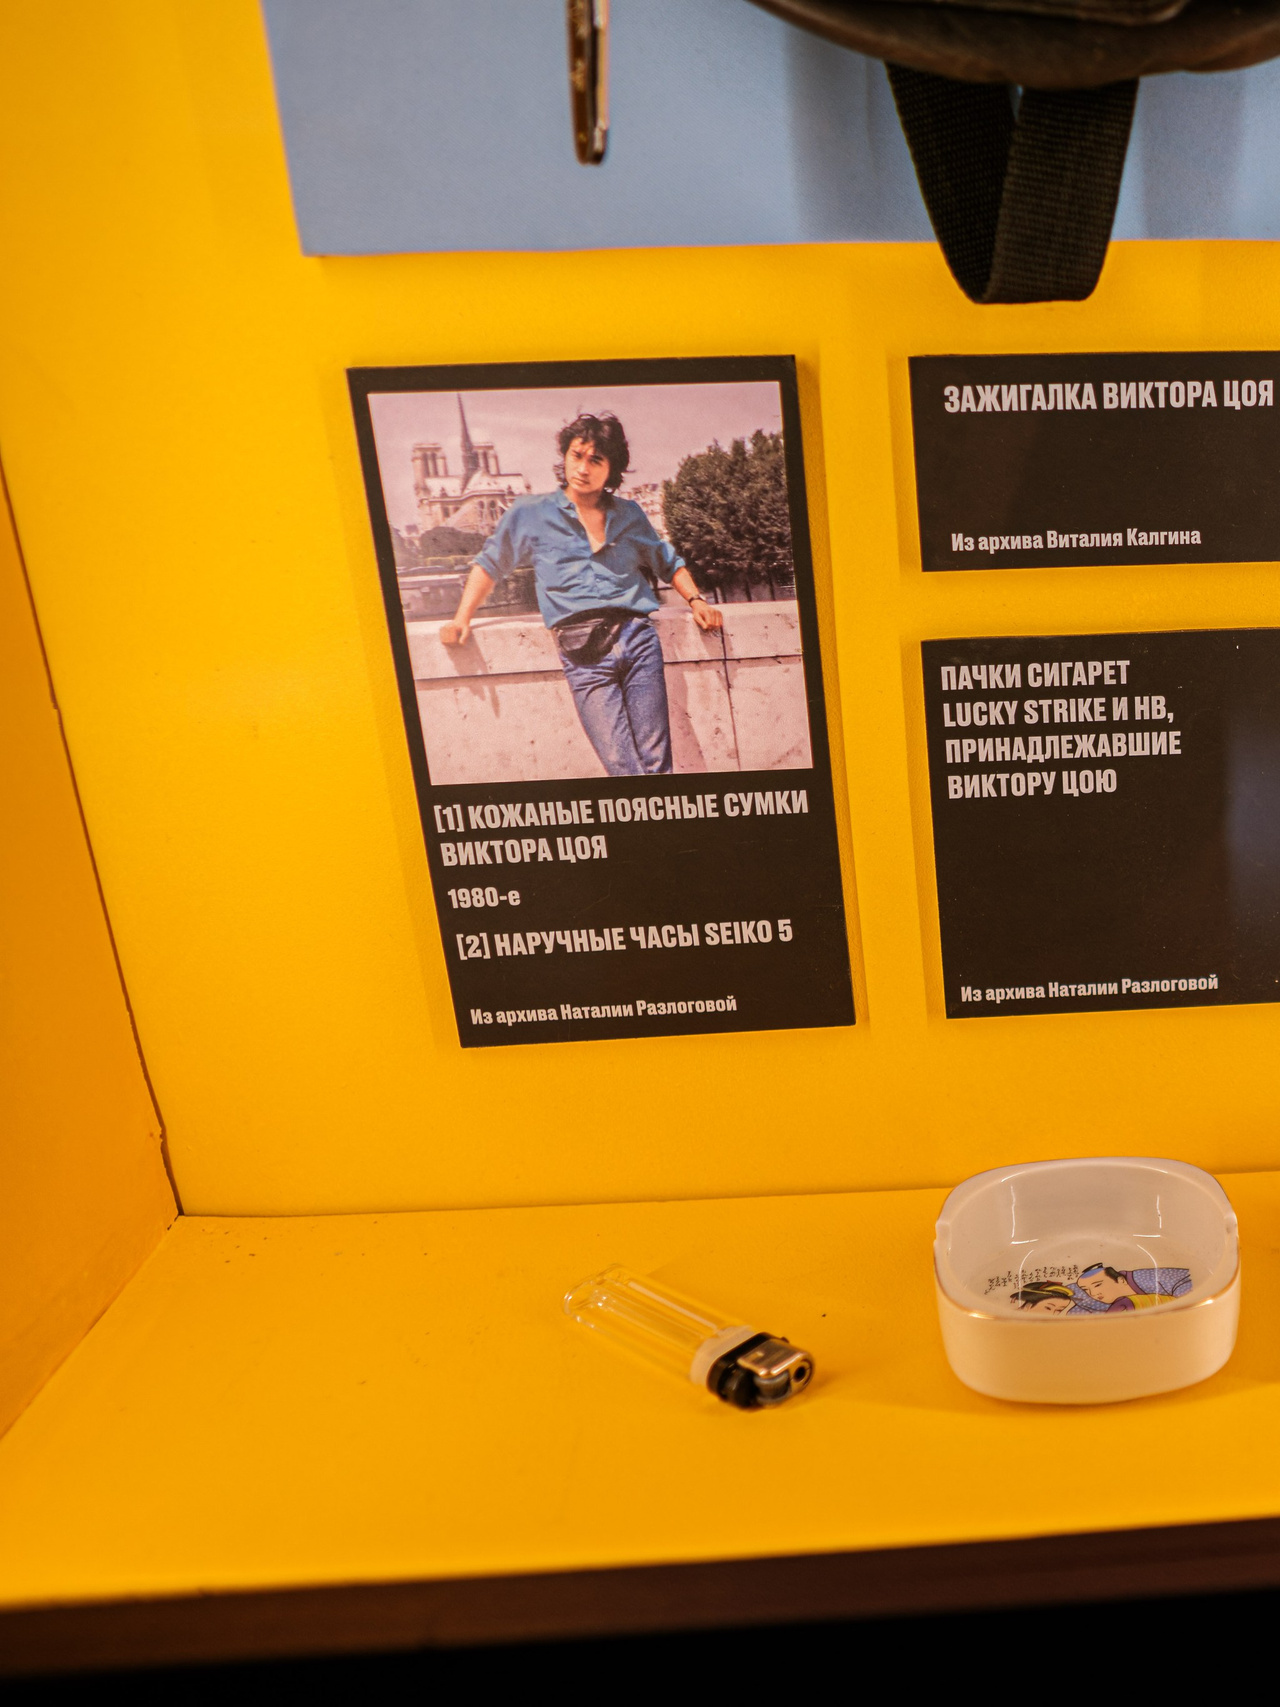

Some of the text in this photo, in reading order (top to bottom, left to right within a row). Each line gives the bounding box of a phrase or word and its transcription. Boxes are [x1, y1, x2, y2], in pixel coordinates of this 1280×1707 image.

[943, 379, 1274, 413] ЗАЖИГАЛКА ВИКТОРА ЦОЯ
[951, 527, 1202, 555] Из архива Виталия Калгина
[940, 659, 1131, 691] ПАЧКИ СИГАРЕТ
[942, 695, 1174, 728] LUCKY STRIKE И HB,
[945, 730, 1182, 764] ПРИНАДЛЕЖАВШИЕ
[947, 768, 1117, 800] ВИКТОРУ ЦОЮ
[433, 789, 809, 834] [1] КОЖАНЫЕ ПОЯСНЫЕ СУМКИ
[439, 834, 608, 867] ВИКТОРА ЦОЯ
[447, 886, 521, 909] 1980-е
[455, 918, 793, 961] [2] НАРУЧНЫЕ ЧАСЫ SEIKO 5
[960, 973, 1219, 1004] Из архива Наталии Разлоговой
[470, 995, 737, 1027] Из архива Наталии Разлоговой
